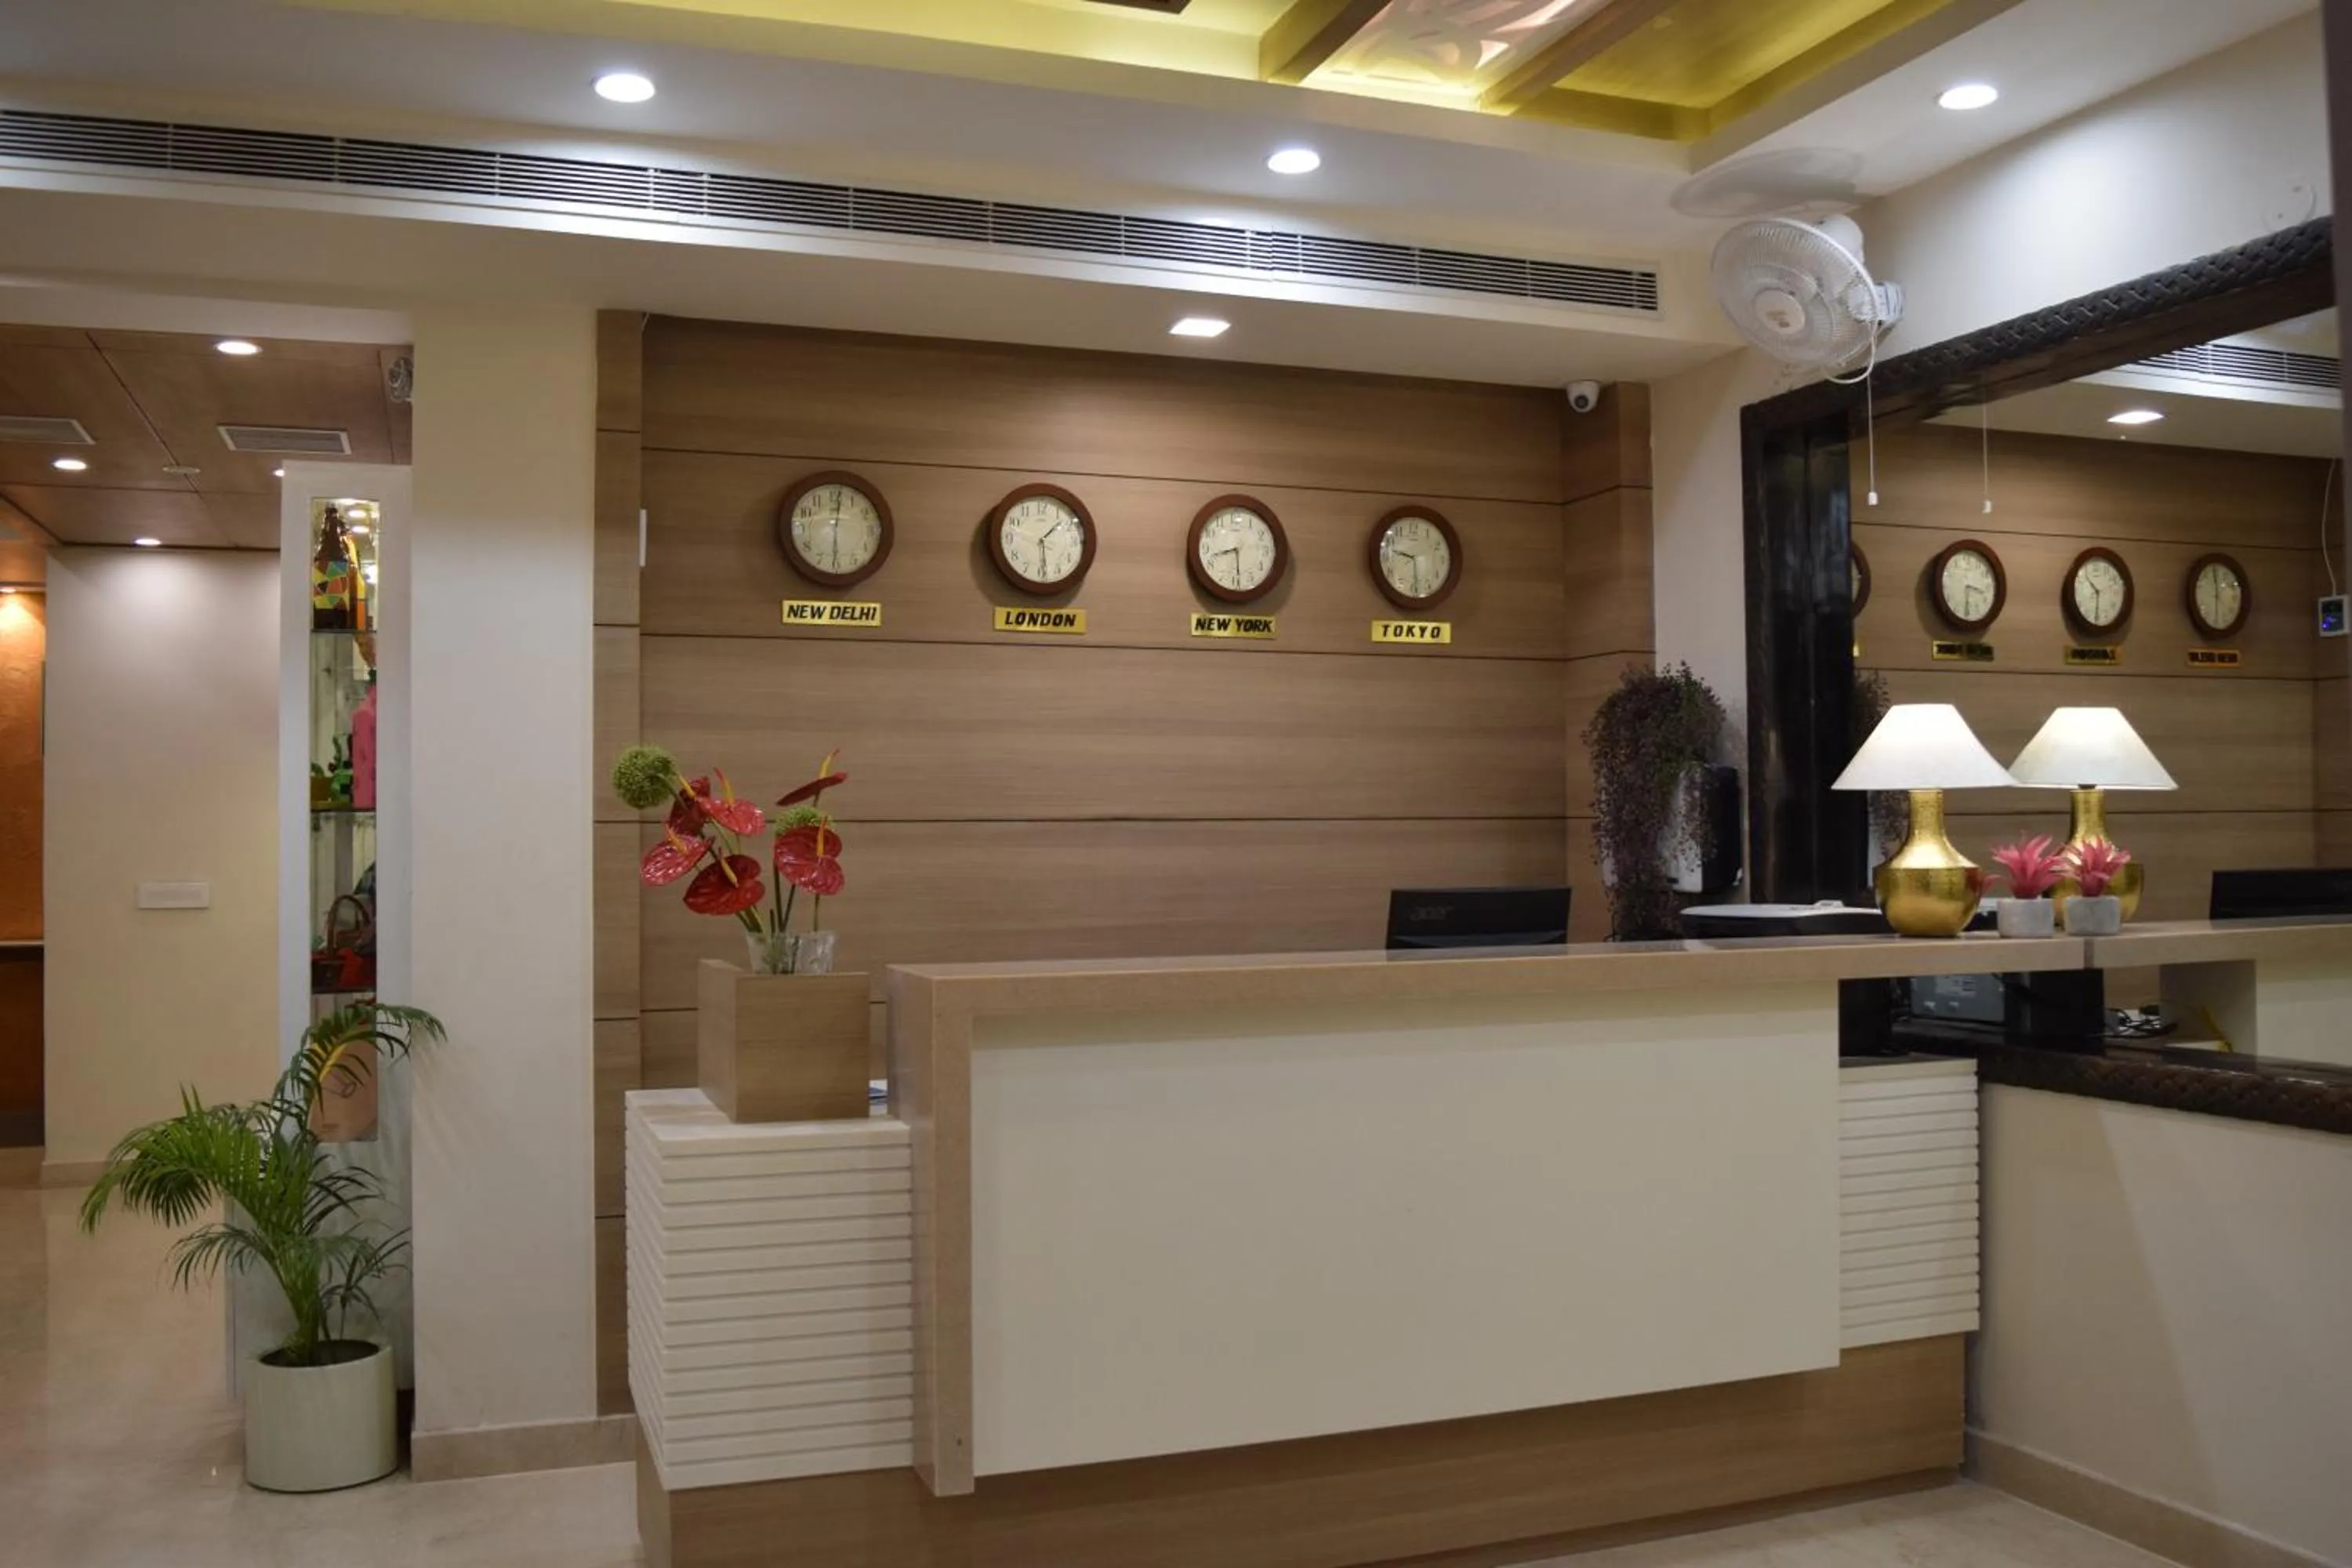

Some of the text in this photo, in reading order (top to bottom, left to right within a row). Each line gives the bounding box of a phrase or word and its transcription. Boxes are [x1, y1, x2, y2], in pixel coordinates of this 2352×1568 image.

[813, 495, 821, 510] 11
[1037, 501, 1047, 515] 12
[1022, 505, 1029, 517] 11
[1216, 515, 1224, 528] 11
[786, 604, 877, 621] NEW DELHI
[1004, 611, 1077, 627] LONDON
[1194, 617, 1274, 633] NEW YORK
[1381, 625, 1442, 639] TOKYO
